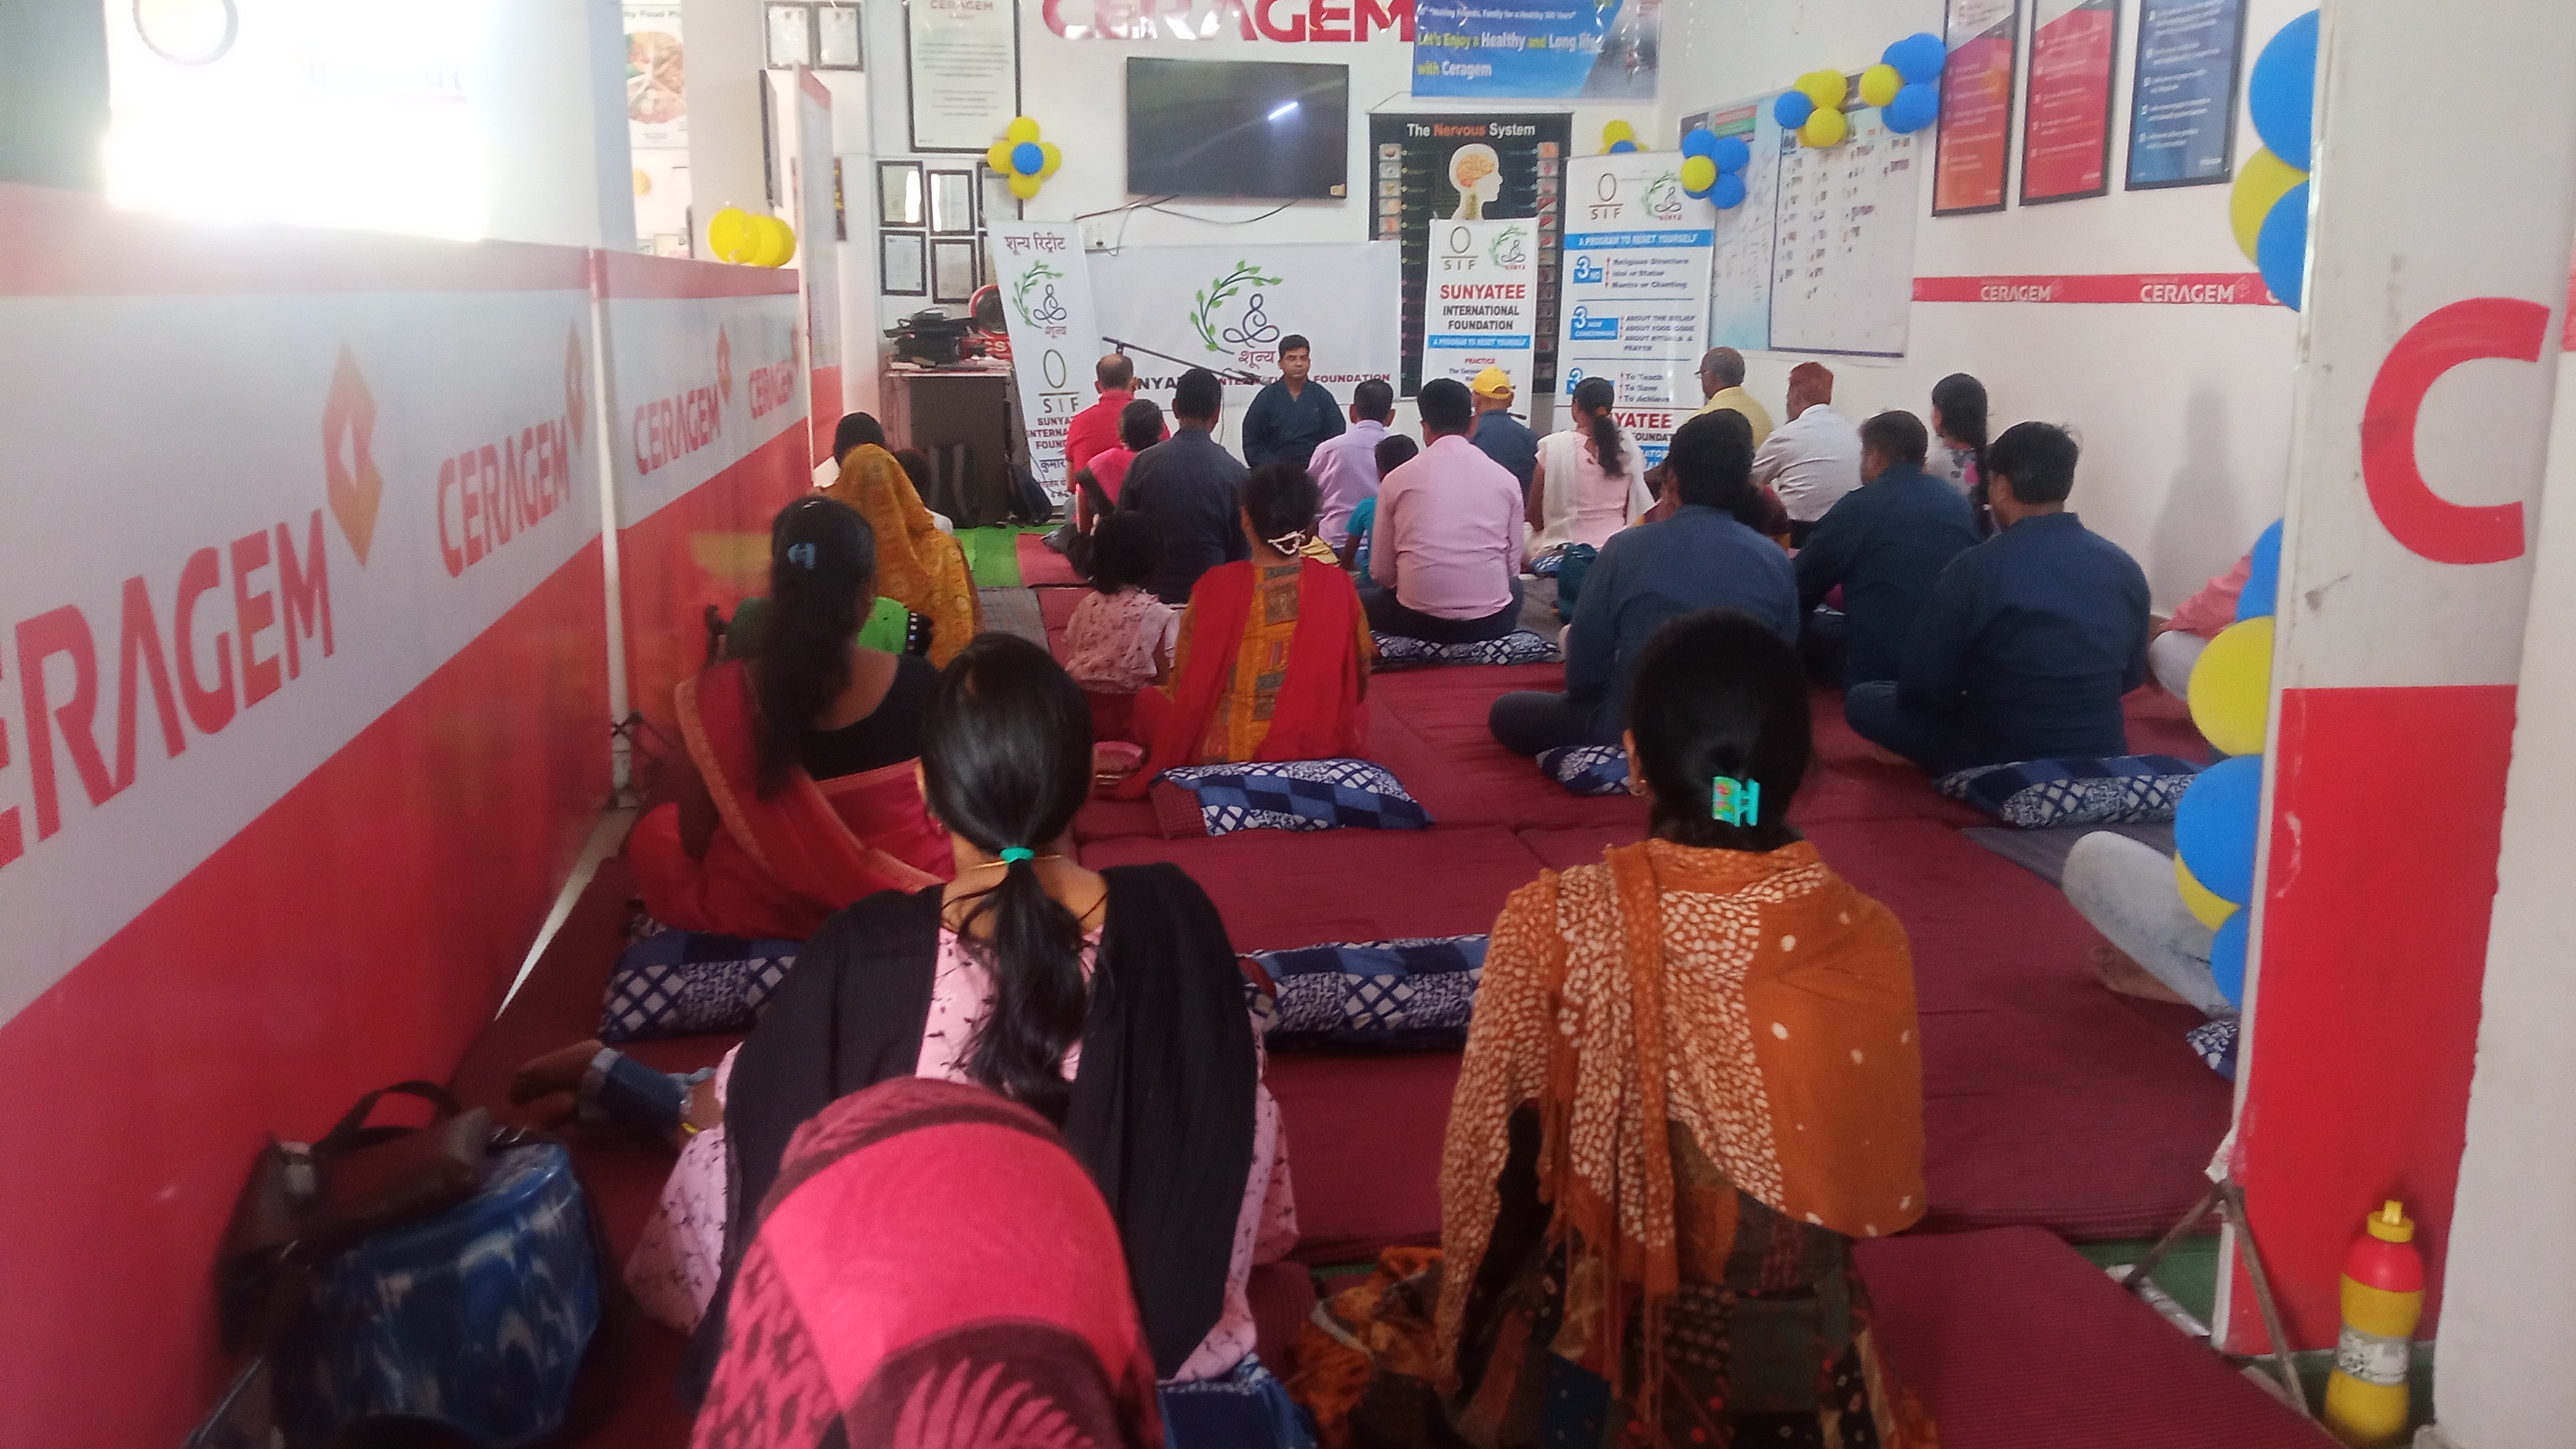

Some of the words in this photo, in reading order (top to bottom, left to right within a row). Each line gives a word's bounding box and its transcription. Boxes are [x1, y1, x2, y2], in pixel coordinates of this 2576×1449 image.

[1443, 32, 1470, 50] Enjoy
[1481, 32, 1525, 52] Healthy
[1548, 34, 1577, 52] Long
[1442, 62, 1492, 79] Ceragem
[1407, 123, 1430, 136] The
[1433, 124, 1486, 137] Nervous
[1489, 122, 1536, 139] System
[1004, 236, 1030, 255] शून्य
[1577, 255, 1591, 279] 3
[1440, 284, 1526, 299] SUNYATEE
[1980, 284, 2051, 301] CERAGEM
[2140, 283, 2235, 303] CERAGEM
[1443, 305, 1520, 316] INTERNATIONAL
[1574, 306, 1587, 329] 3
[1448, 320, 1514, 330] FOUNDATION
[1238, 350, 1276, 369] शून्य
[633, 383, 721, 475] CERAGEM
[1037, 416, 1073, 426] SUNYA
[1609, 412, 1672, 428] YATEE
[437, 414, 571, 578] CERAGEM
[0, 508, 334, 868] RAGEM
